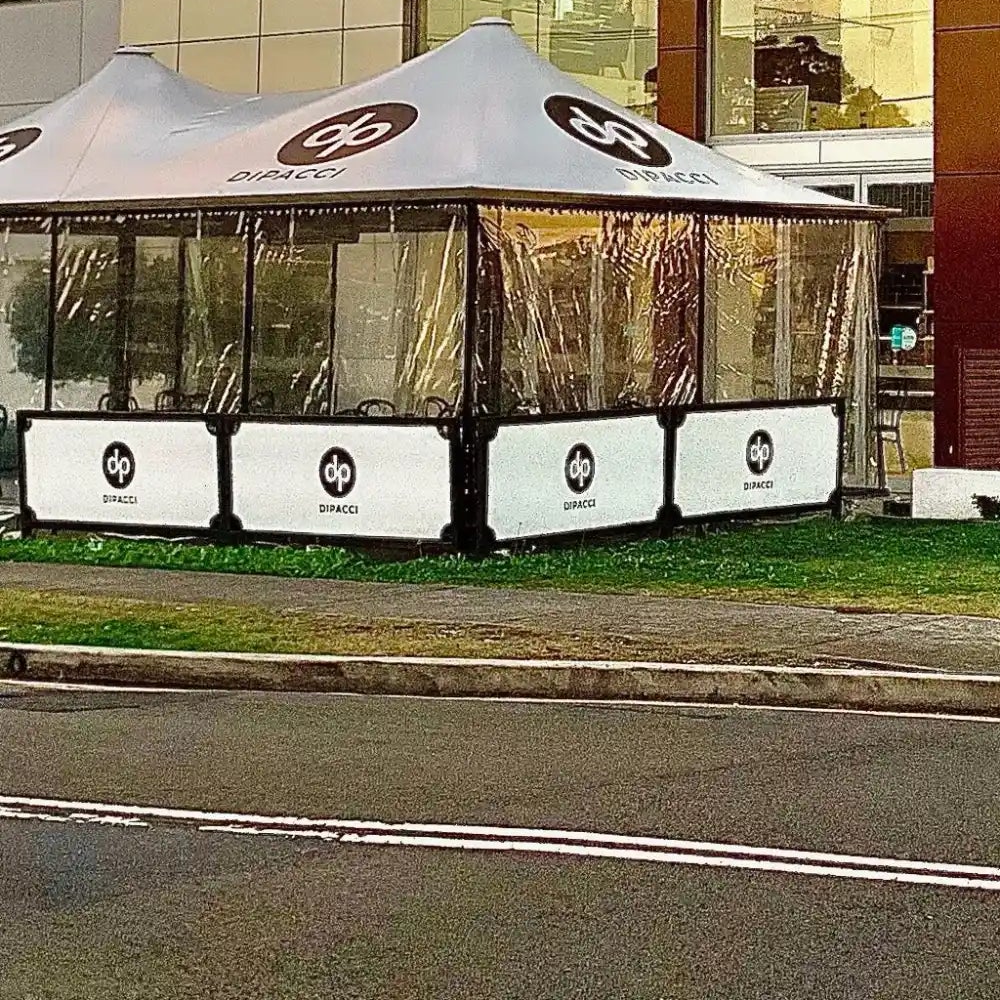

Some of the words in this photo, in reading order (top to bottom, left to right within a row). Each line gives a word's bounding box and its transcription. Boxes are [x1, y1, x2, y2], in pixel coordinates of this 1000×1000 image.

[227, 168, 347, 182] DIPACCI
[616, 168, 719, 185] DIPACCI
[743, 480, 774, 491] DIPACCI
[319, 504, 359, 514] DIPACCI
[563, 499, 596, 512] DIPACCI
